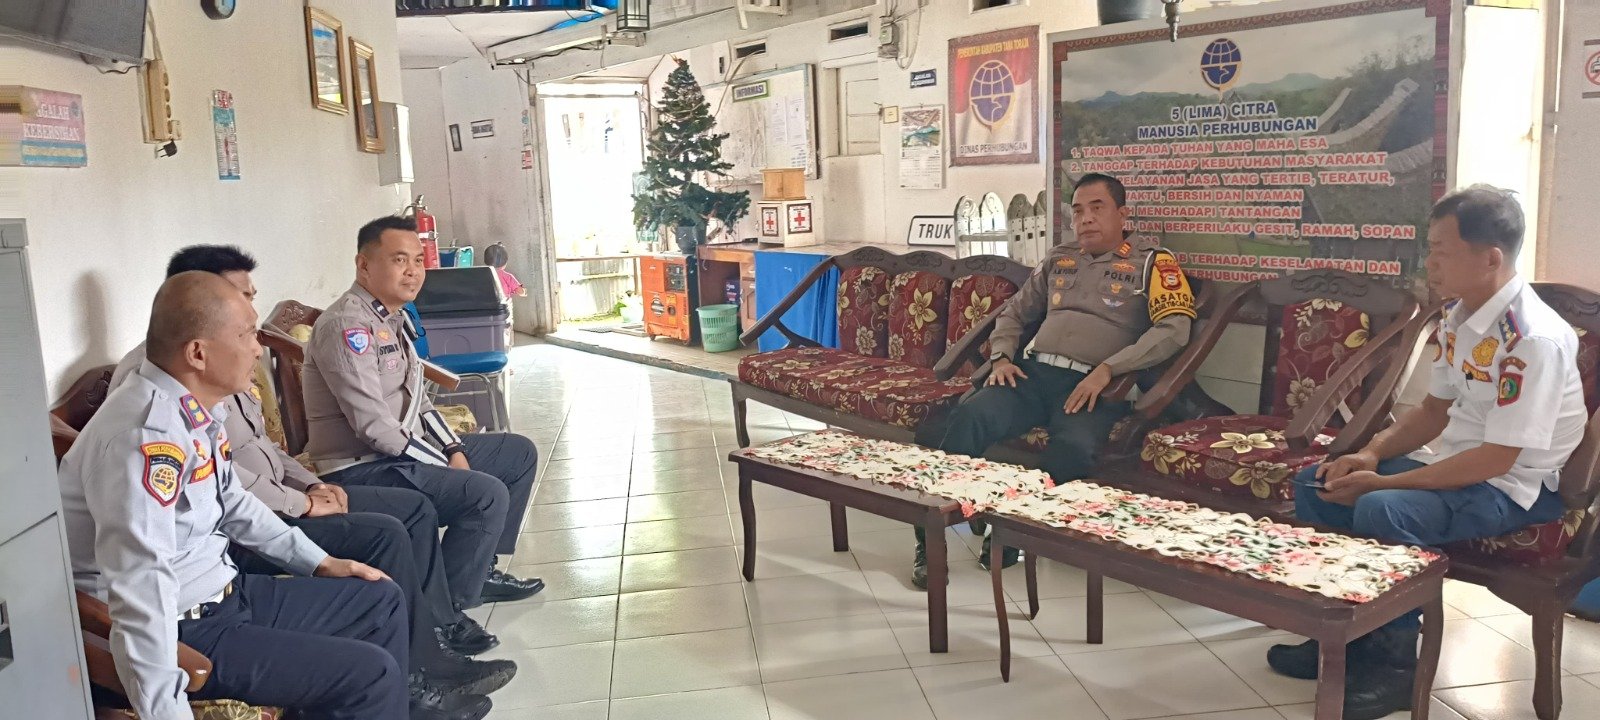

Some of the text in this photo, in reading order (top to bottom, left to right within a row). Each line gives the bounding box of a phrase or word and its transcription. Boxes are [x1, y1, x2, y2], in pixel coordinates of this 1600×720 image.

[736, 85, 764, 98] INFORMASI
[36, 103, 70, 120] GALAH
[1172, 102, 1276, 121] 5 (LIMA) CITRA
[1139, 118, 1317, 139] MANUSIA PERHUBUNGAN
[1071, 136, 1329, 158] 1. TAQWA KEPADA TUHAN YANG MAHA ESA
[1071, 153, 1387, 172] 2. TANGGAP TERHADAP KEBUTUHAN MASYARAKAT
[1187, 174, 1219, 185] JASA
[1223, 173, 1259, 185] YANG
[1263, 173, 1315, 187] TERTIB,
[1319, 171, 1394, 186] TERATUR,
[1168, 190, 1212, 201] BERSIH
[1215, 190, 1241, 201] DAN
[1245, 189, 1303, 201] NYAMAN
[1138, 207, 1216, 217] MENGHADAPI
[1220, 206, 1302, 218] TANTANGAN
[919, 223, 953, 239] TRUK
[1139, 221, 1163, 232] DAN
[1165, 222, 1255, 234] BERPERILAKU
[1255, 224, 1299, 238] GESIT,
[1302, 225, 1360, 240] RAMAH,
[1361, 226, 1416, 240] SOPAN
[1190, 253, 1257, 266] TERHADAP
[1260, 257, 1364, 272] KESELAMATAN
[1369, 260, 1401, 274] DAN
[1104, 270, 1136, 283] POLRI
